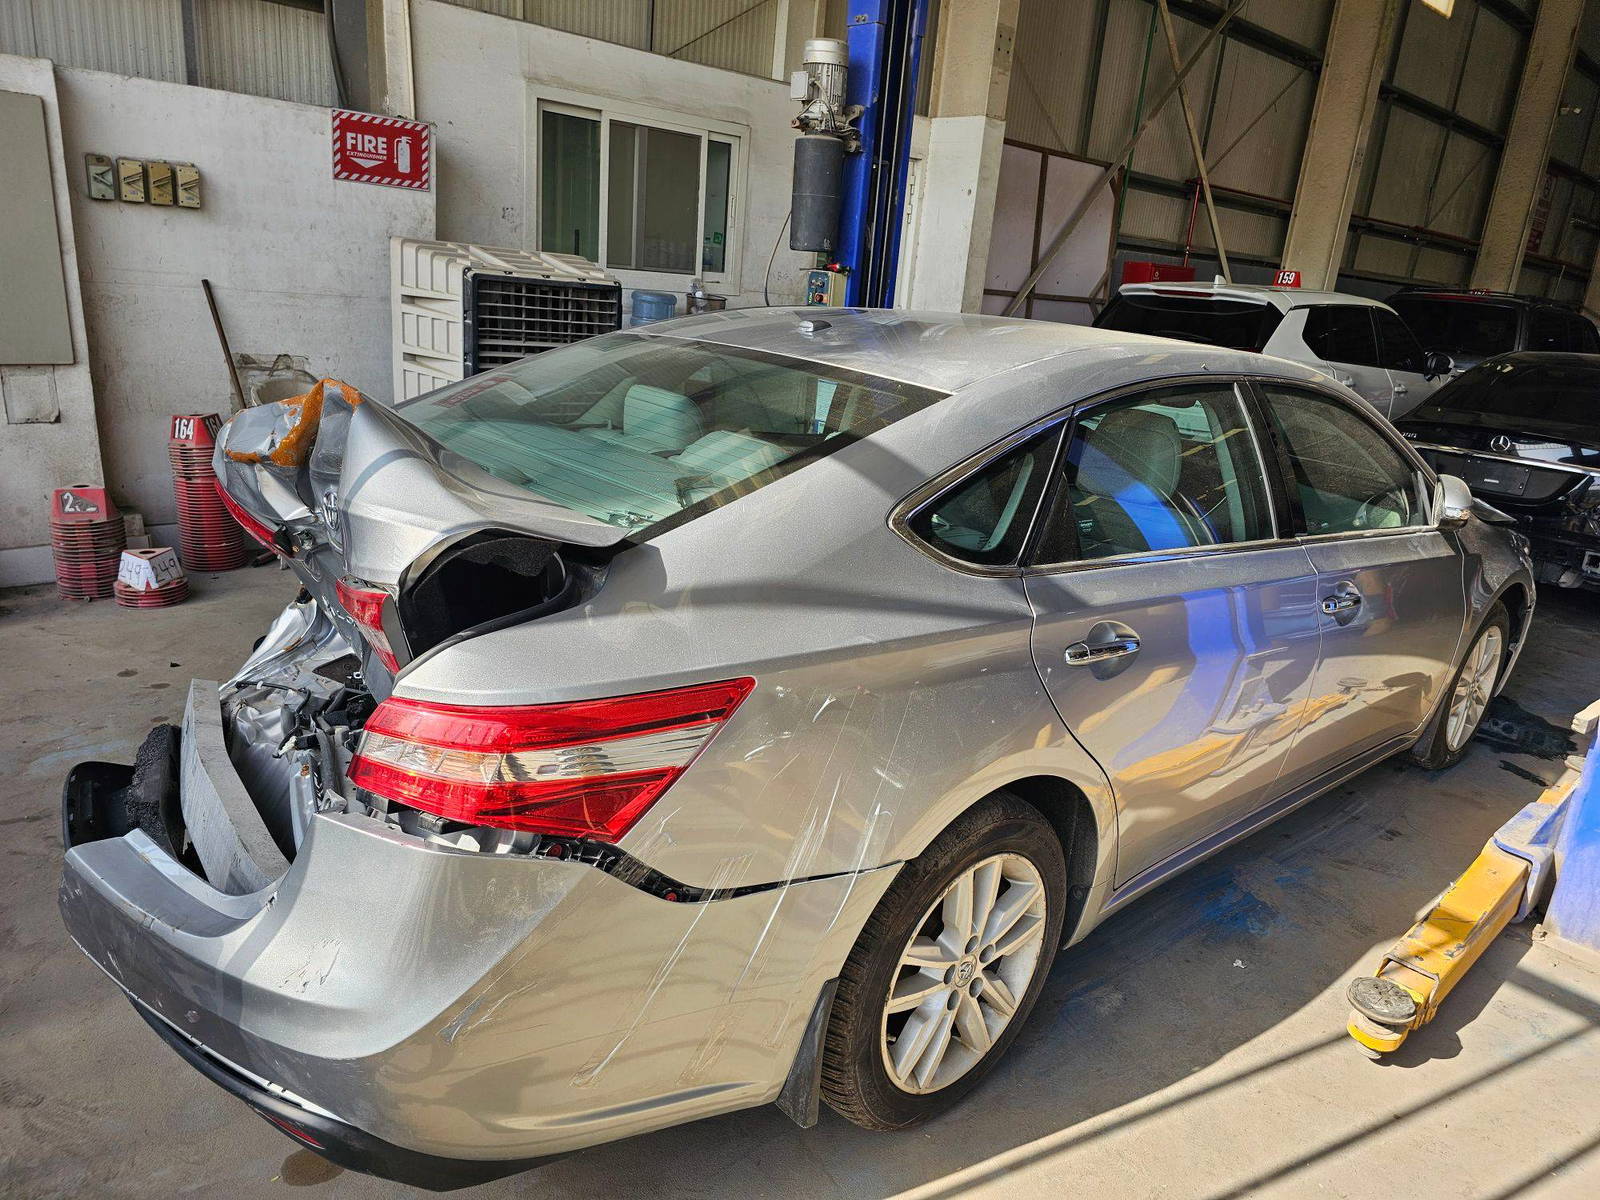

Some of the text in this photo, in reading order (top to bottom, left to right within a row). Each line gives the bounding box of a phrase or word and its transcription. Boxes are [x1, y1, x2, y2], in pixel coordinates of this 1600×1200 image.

[346, 132, 387, 155] FIRE
[346, 151, 387, 160] EXTINGUISHER
[1278, 271, 1296, 284] 159
[175, 417, 194, 440] 164
[152, 558, 180, 583] 249
